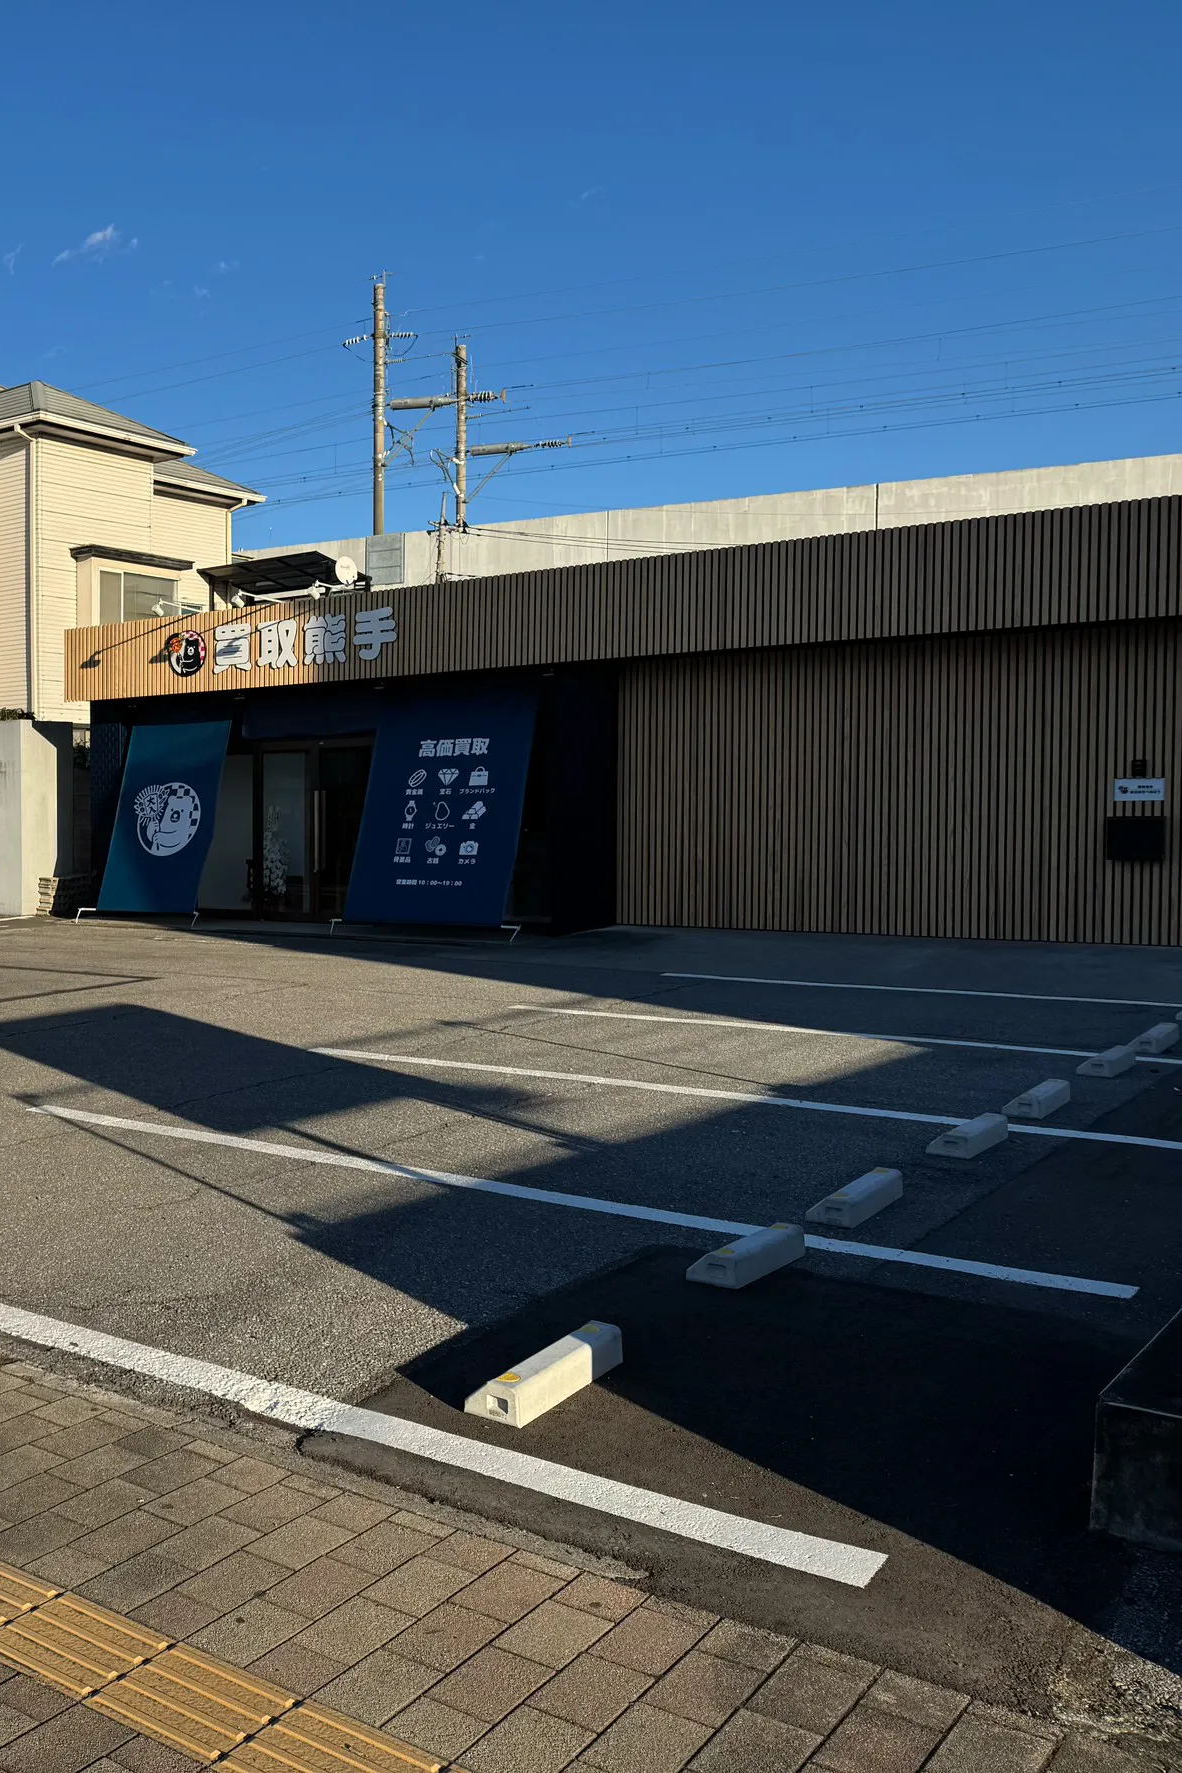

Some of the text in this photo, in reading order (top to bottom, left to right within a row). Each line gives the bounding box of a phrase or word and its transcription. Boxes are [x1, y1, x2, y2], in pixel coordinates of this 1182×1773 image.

[213, 606, 398, 674] 買取熊手
[418, 738, 490, 757] 高価買取
[424, 822, 455, 830] ジュエリー
